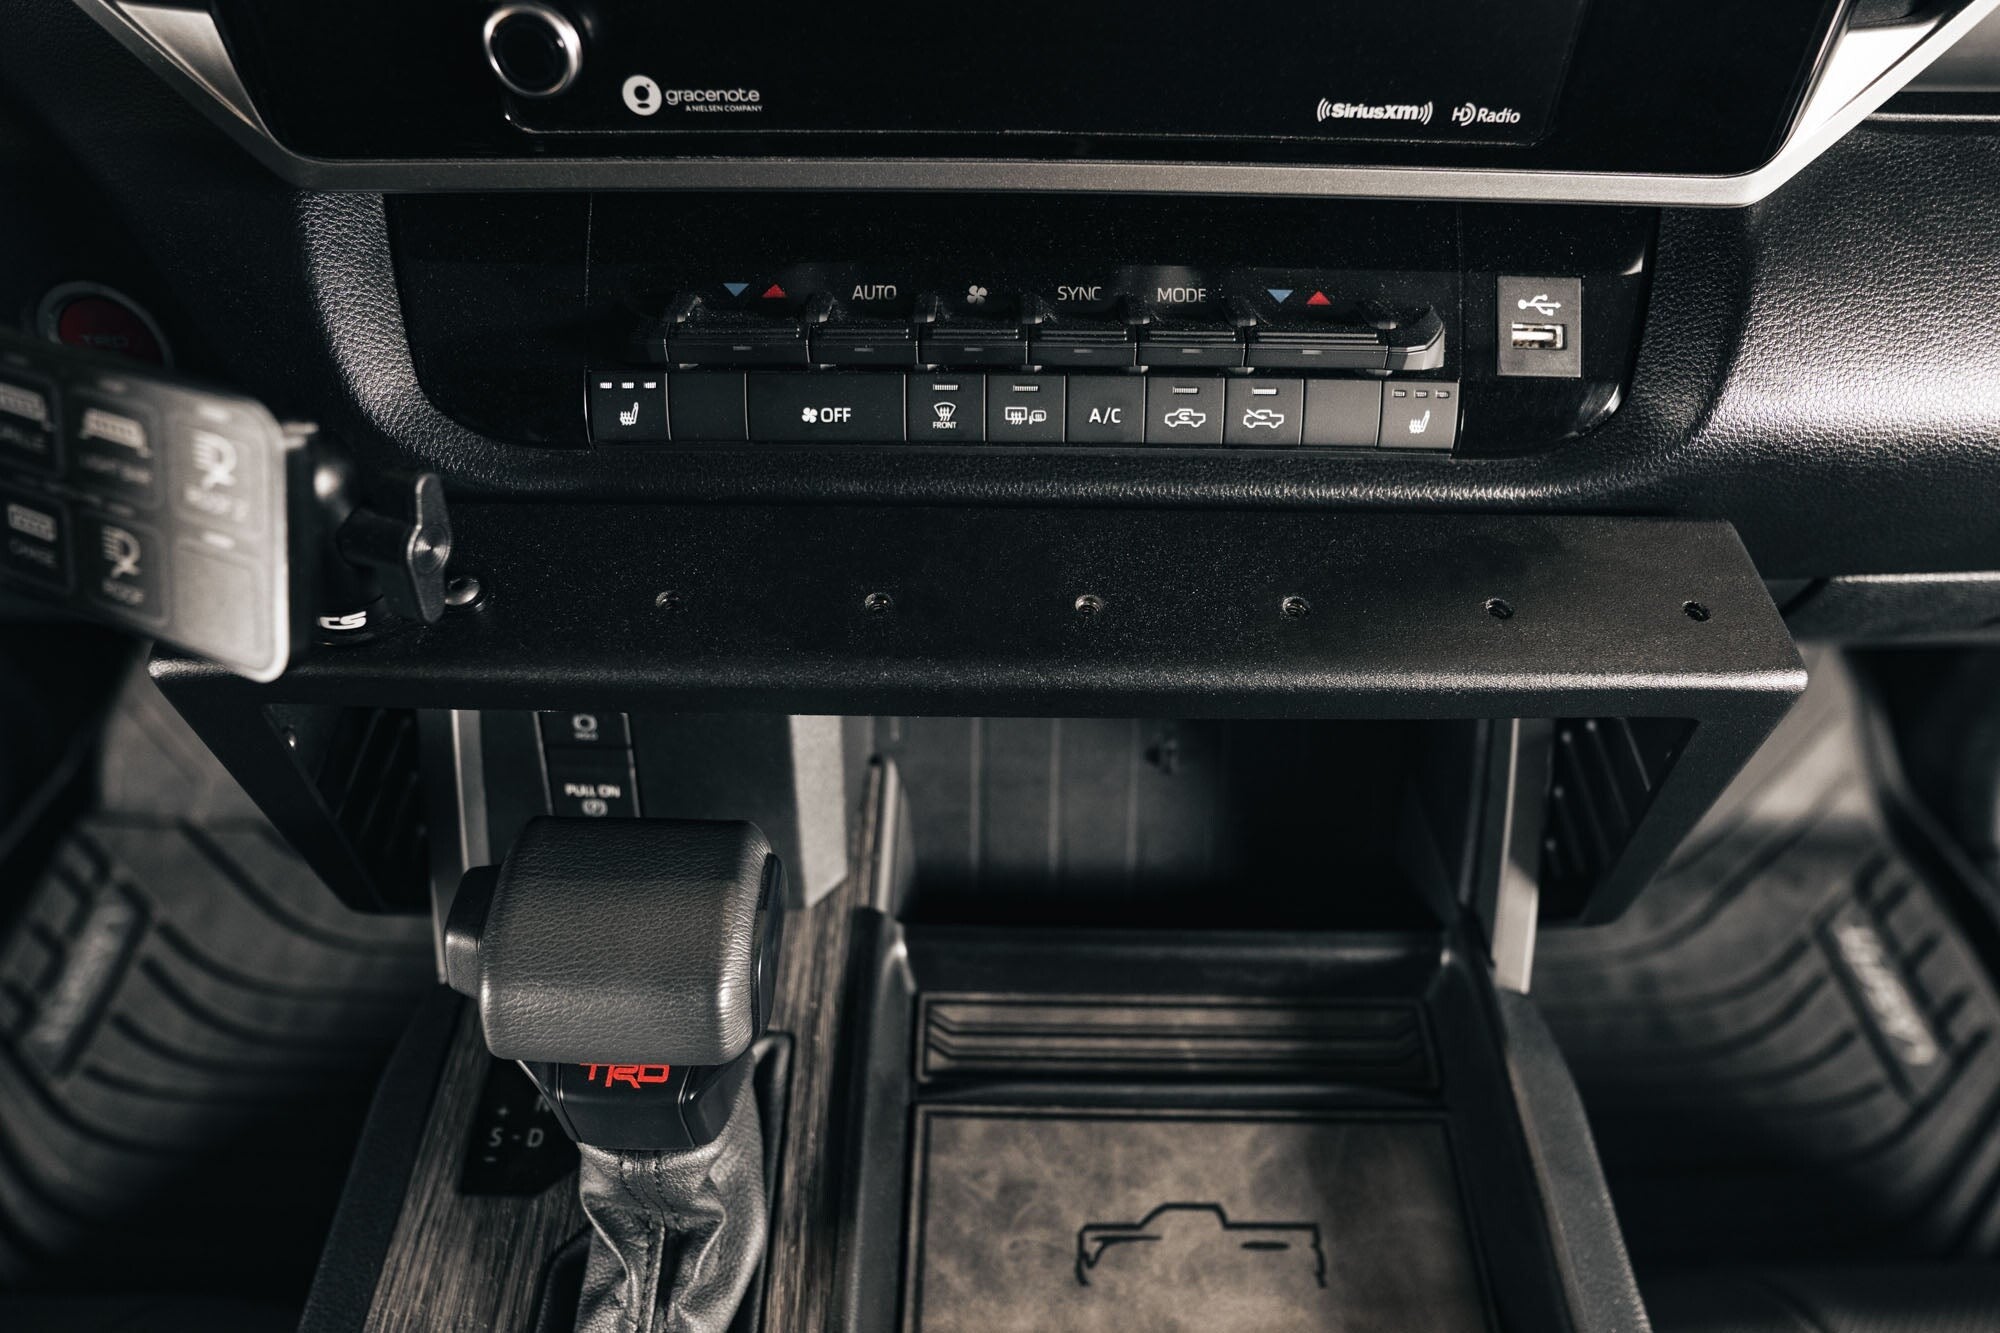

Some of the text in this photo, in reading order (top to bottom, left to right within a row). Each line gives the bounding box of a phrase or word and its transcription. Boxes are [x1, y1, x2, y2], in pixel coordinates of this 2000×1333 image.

[666, 88, 760, 105] gracenote
[1477, 107, 1521, 124] Radio
[851, 284, 898, 301] AUTO
[1057, 286, 1103, 302] SYNC
[1157, 287, 1207, 304] MODE
[820, 407, 852, 423] OFF
[1089, 406, 1122, 425] A/C
[932, 421, 957, 429] FRONT
[564, 783, 621, 799] PULL ON
[580, 1063, 671, 1089] TRD
